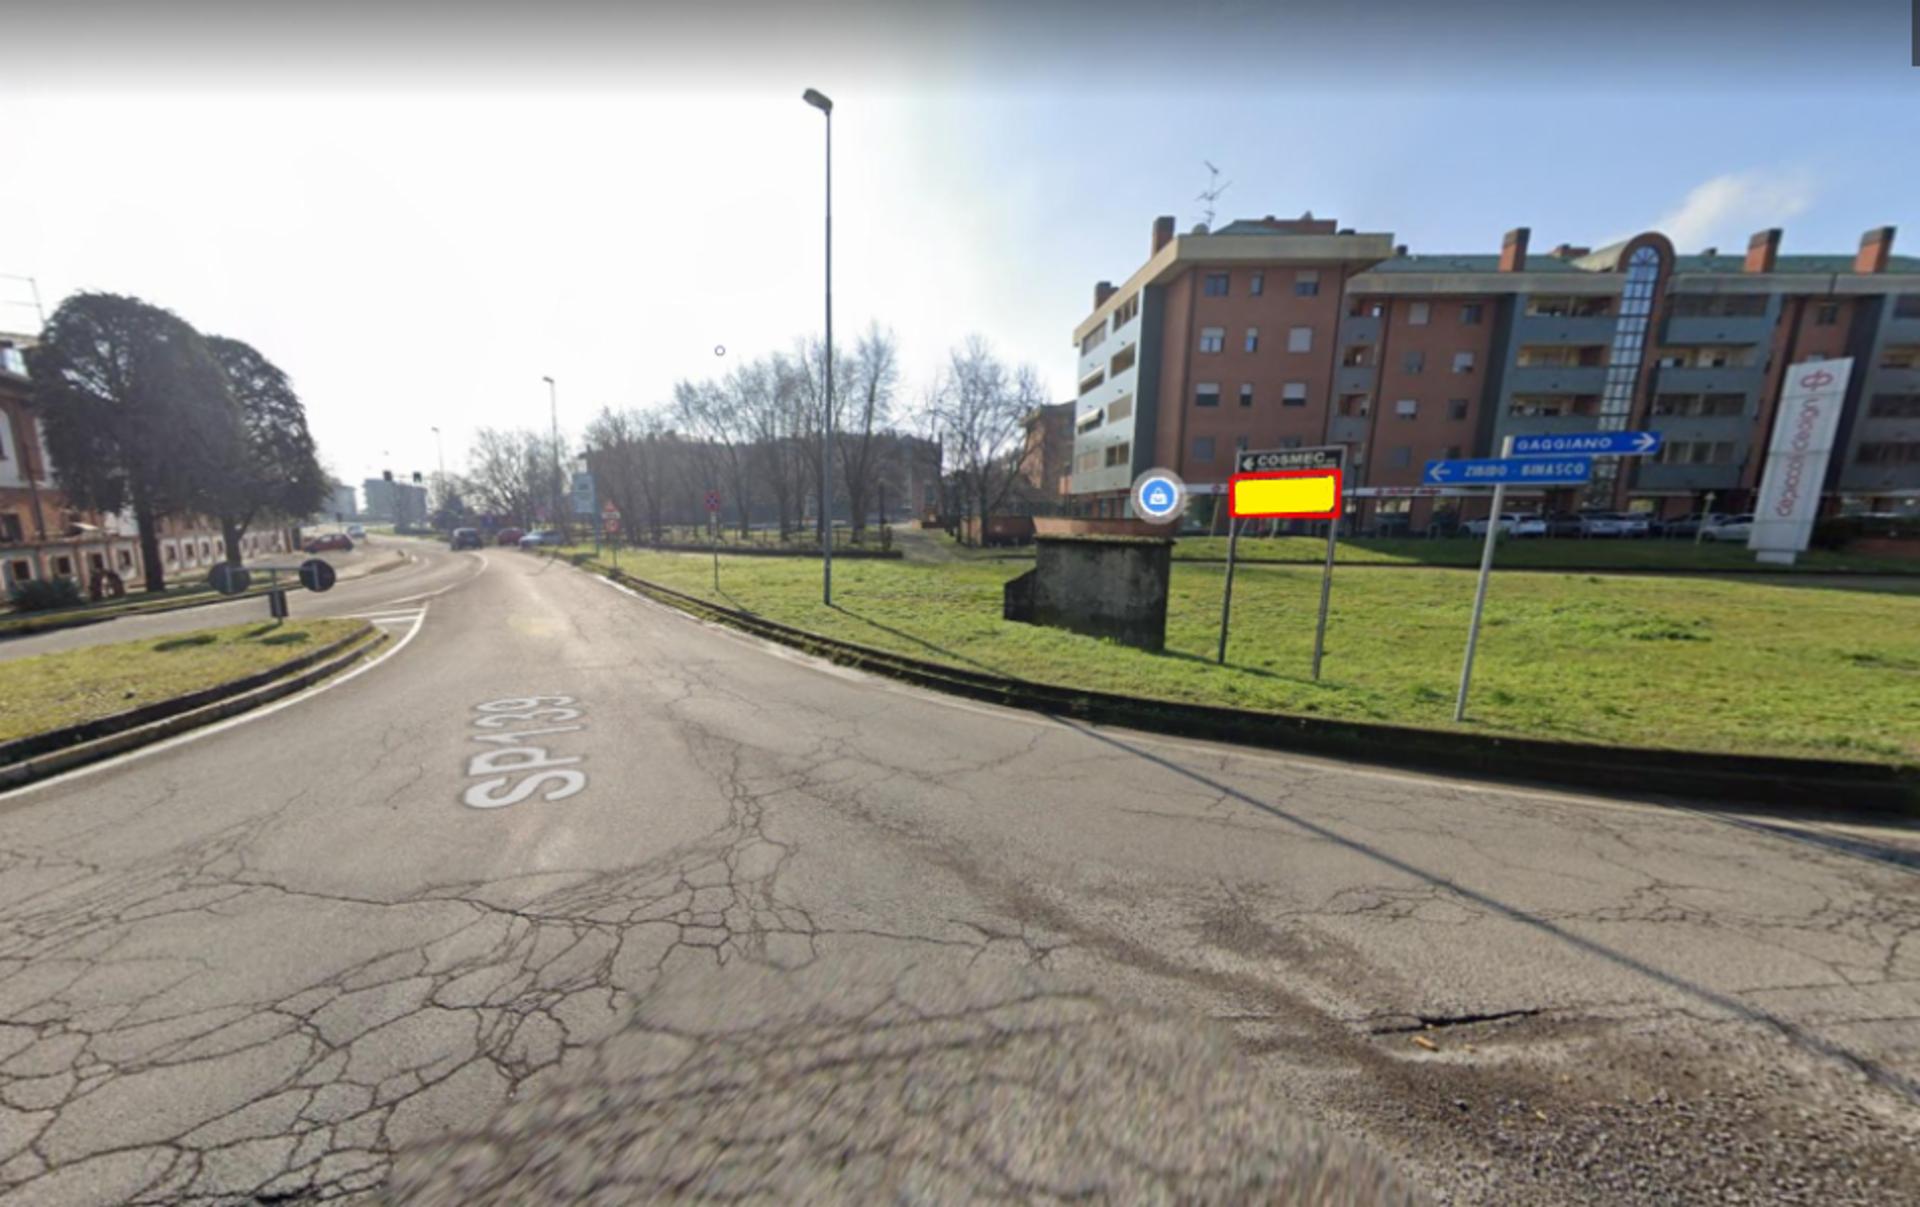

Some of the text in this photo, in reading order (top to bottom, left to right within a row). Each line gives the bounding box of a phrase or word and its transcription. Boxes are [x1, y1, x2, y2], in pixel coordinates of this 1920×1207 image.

[1517, 437, 1612, 450] GAGGIANO
[1257, 452, 1326, 466] COSMEC
[1521, 462, 1585, 476] BINASCO
[463, 696, 585, 809] SP139
